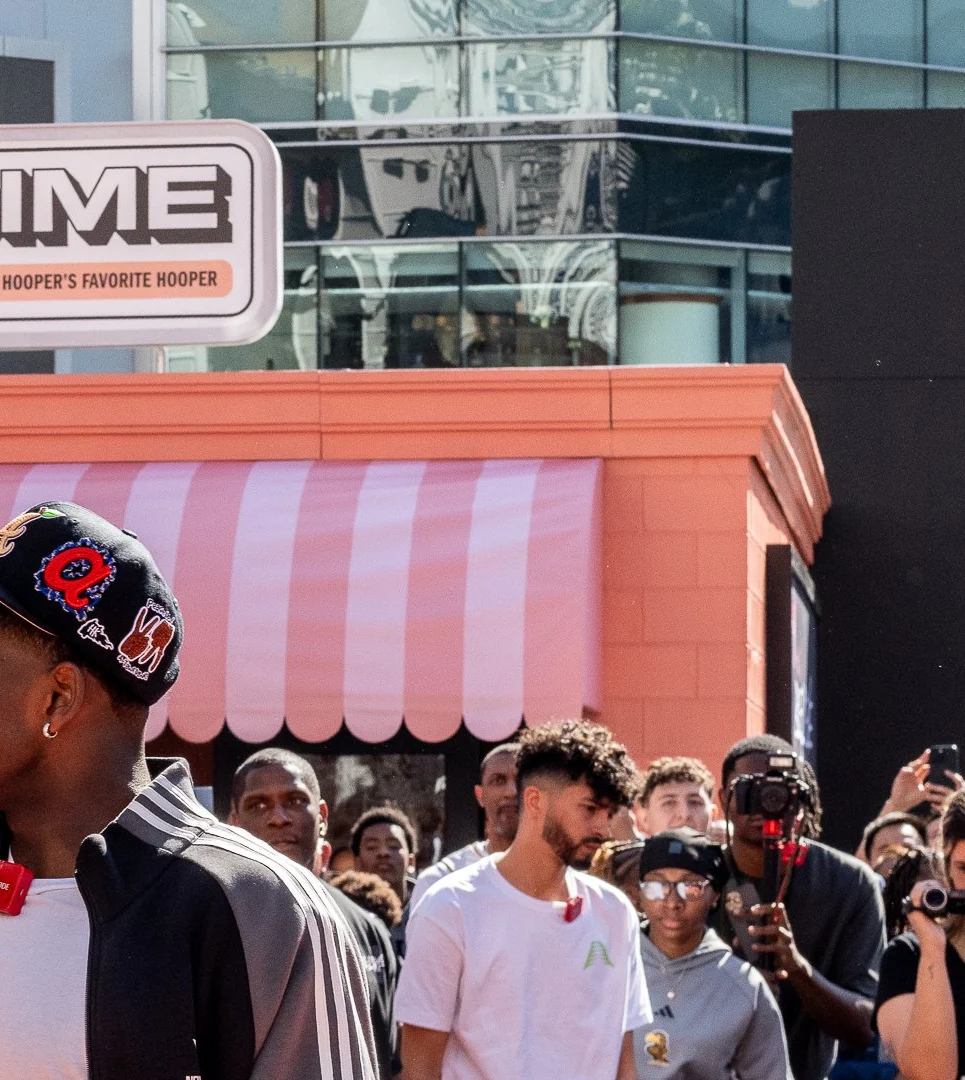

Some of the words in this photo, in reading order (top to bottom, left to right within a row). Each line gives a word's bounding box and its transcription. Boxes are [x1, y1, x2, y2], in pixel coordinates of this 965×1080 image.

[2, 273, 77, 290] HOOPER'S
[82, 271, 152, 289] FAVORITE
[157, 270, 218, 288] HOOPER
